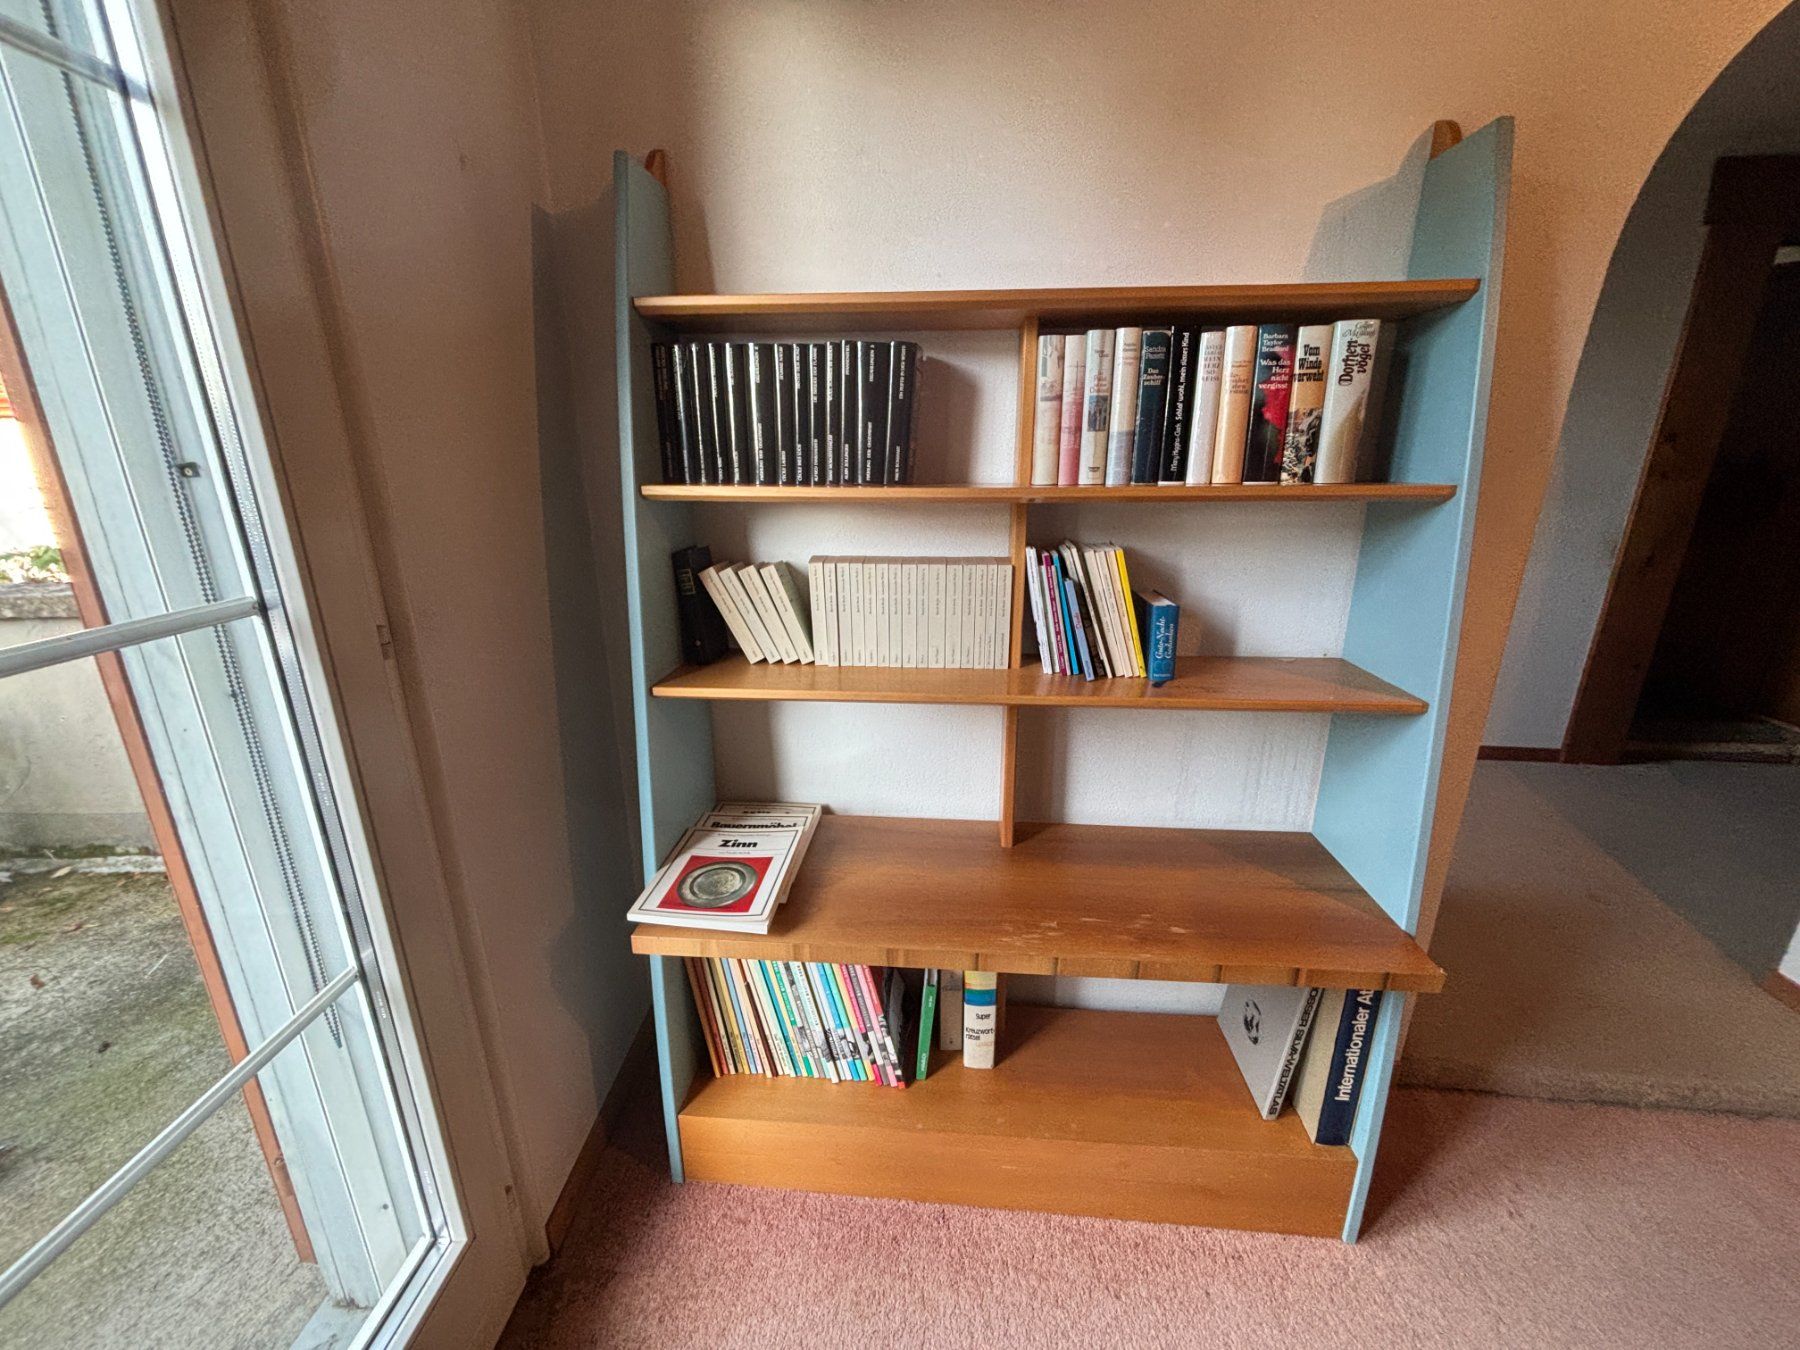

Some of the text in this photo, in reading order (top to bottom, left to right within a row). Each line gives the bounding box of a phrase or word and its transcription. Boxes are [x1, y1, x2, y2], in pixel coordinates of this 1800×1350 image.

[1303, 344, 1320, 356] Vom
[1355, 343, 1372, 374] vögel
[1298, 357, 1322, 370] Winde
[1175, 403, 1184, 421] Schlaf
[1182, 332, 1190, 347] Kind
[1293, 370, 1324, 383] verweht
[718, 839, 758, 848] Zinn
[1299, 988, 1319, 1027] OSSER
[1334, 1008, 1371, 1102] Internationaler
